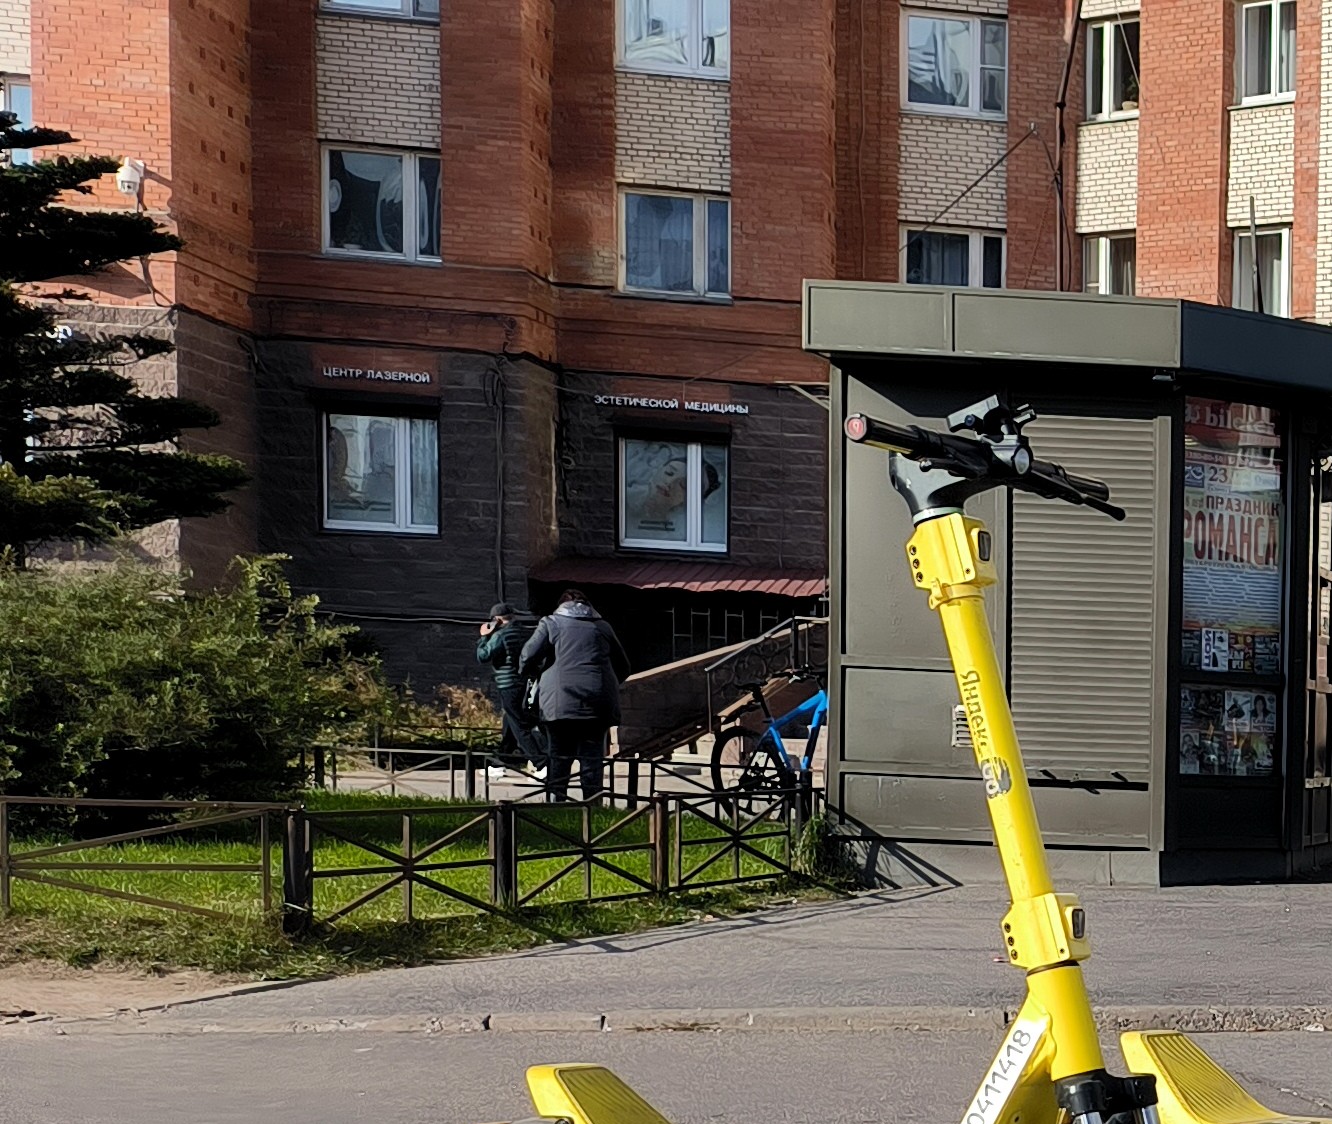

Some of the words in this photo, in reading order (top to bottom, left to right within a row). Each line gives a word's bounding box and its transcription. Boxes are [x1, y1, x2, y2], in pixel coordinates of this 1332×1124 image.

[323, 366, 363, 378] ЦЕНТР
[366, 369, 431, 383] ЛАЗЕРНОЙ
[594, 394, 679, 409] ЭСТЕТИЧЕСКОЙ
[684, 401, 749, 414] МЕДИЦИНЫ
[1207, 465, 1229, 484] 23
